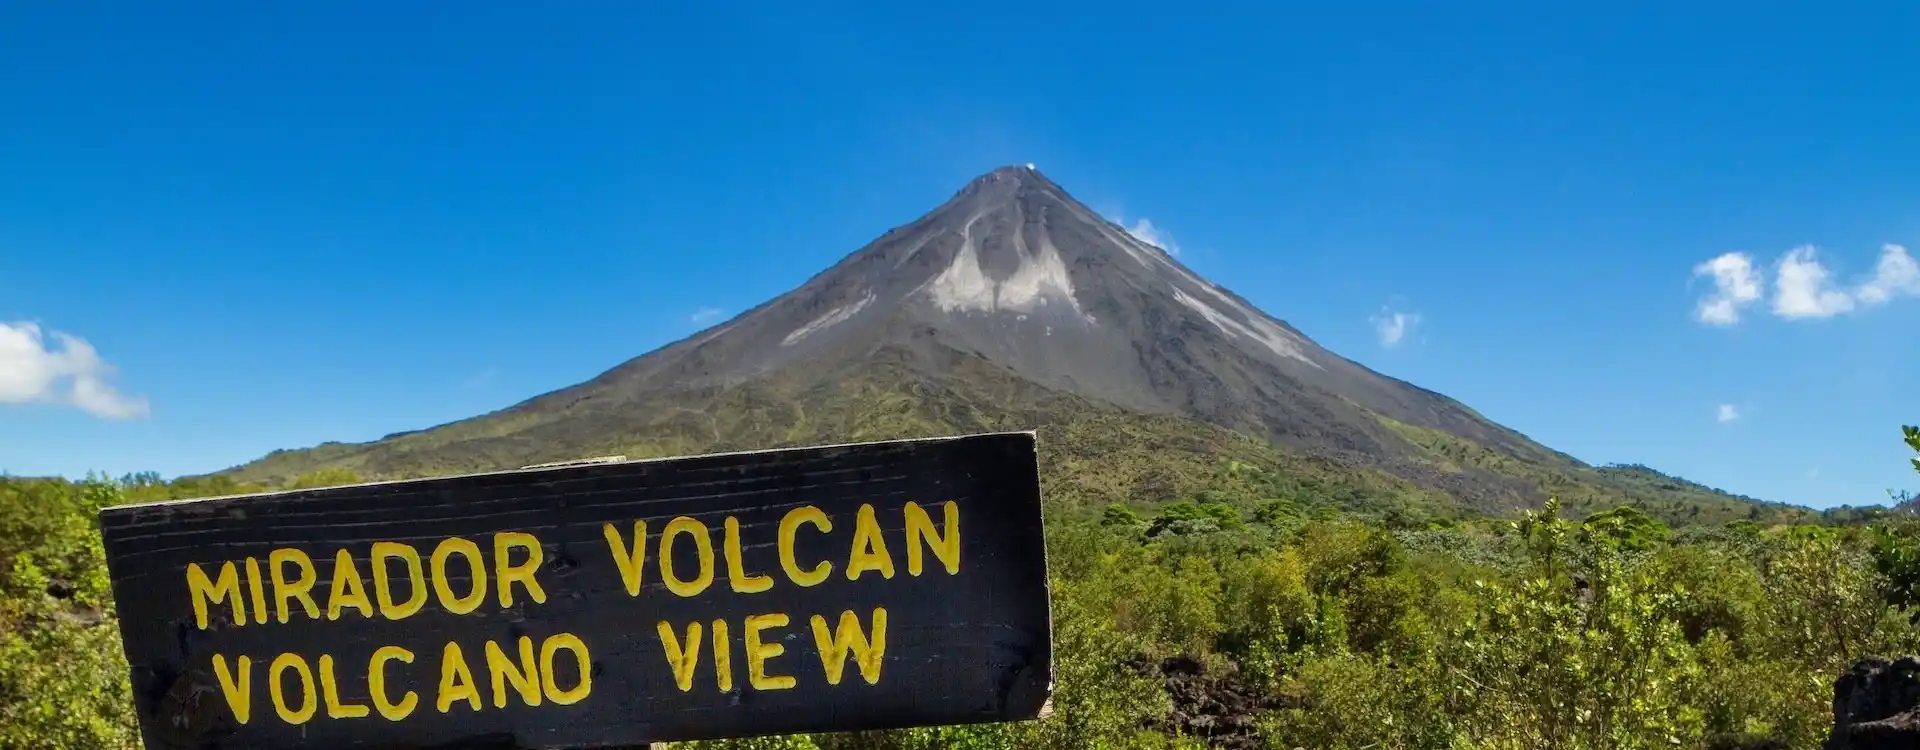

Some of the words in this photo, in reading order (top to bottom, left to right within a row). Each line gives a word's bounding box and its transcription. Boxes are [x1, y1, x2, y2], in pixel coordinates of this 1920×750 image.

[186, 530, 547, 630] MIRADOR
[603, 500, 962, 597] VOLCAN
[212, 632, 593, 725] VOLCANO
[656, 606, 888, 693] VIEW
